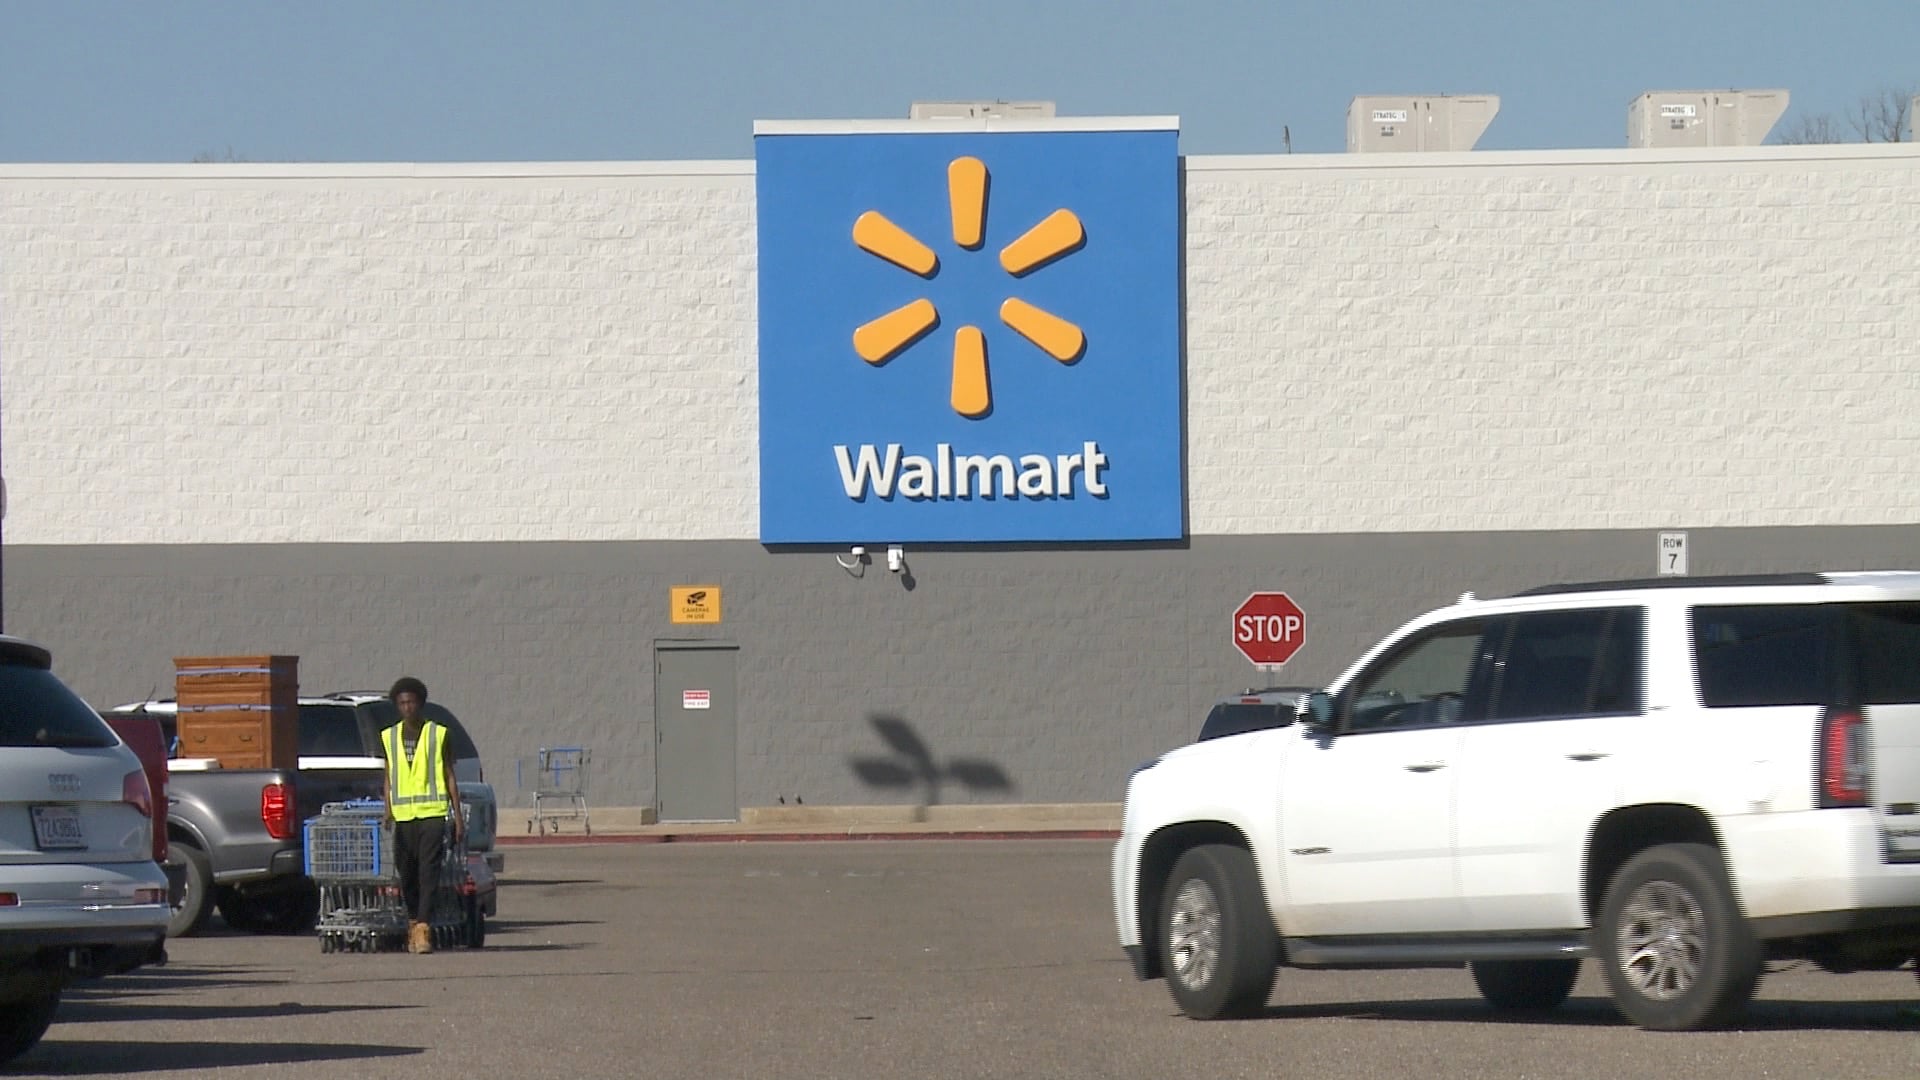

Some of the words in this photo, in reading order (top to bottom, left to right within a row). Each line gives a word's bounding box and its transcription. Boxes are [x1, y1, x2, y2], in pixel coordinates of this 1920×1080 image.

[833, 441, 1107, 500] Walmart
[1663, 538, 1683, 549] ROW
[1668, 553, 1678, 570] 7
[1238, 614, 1301, 643] STOP
